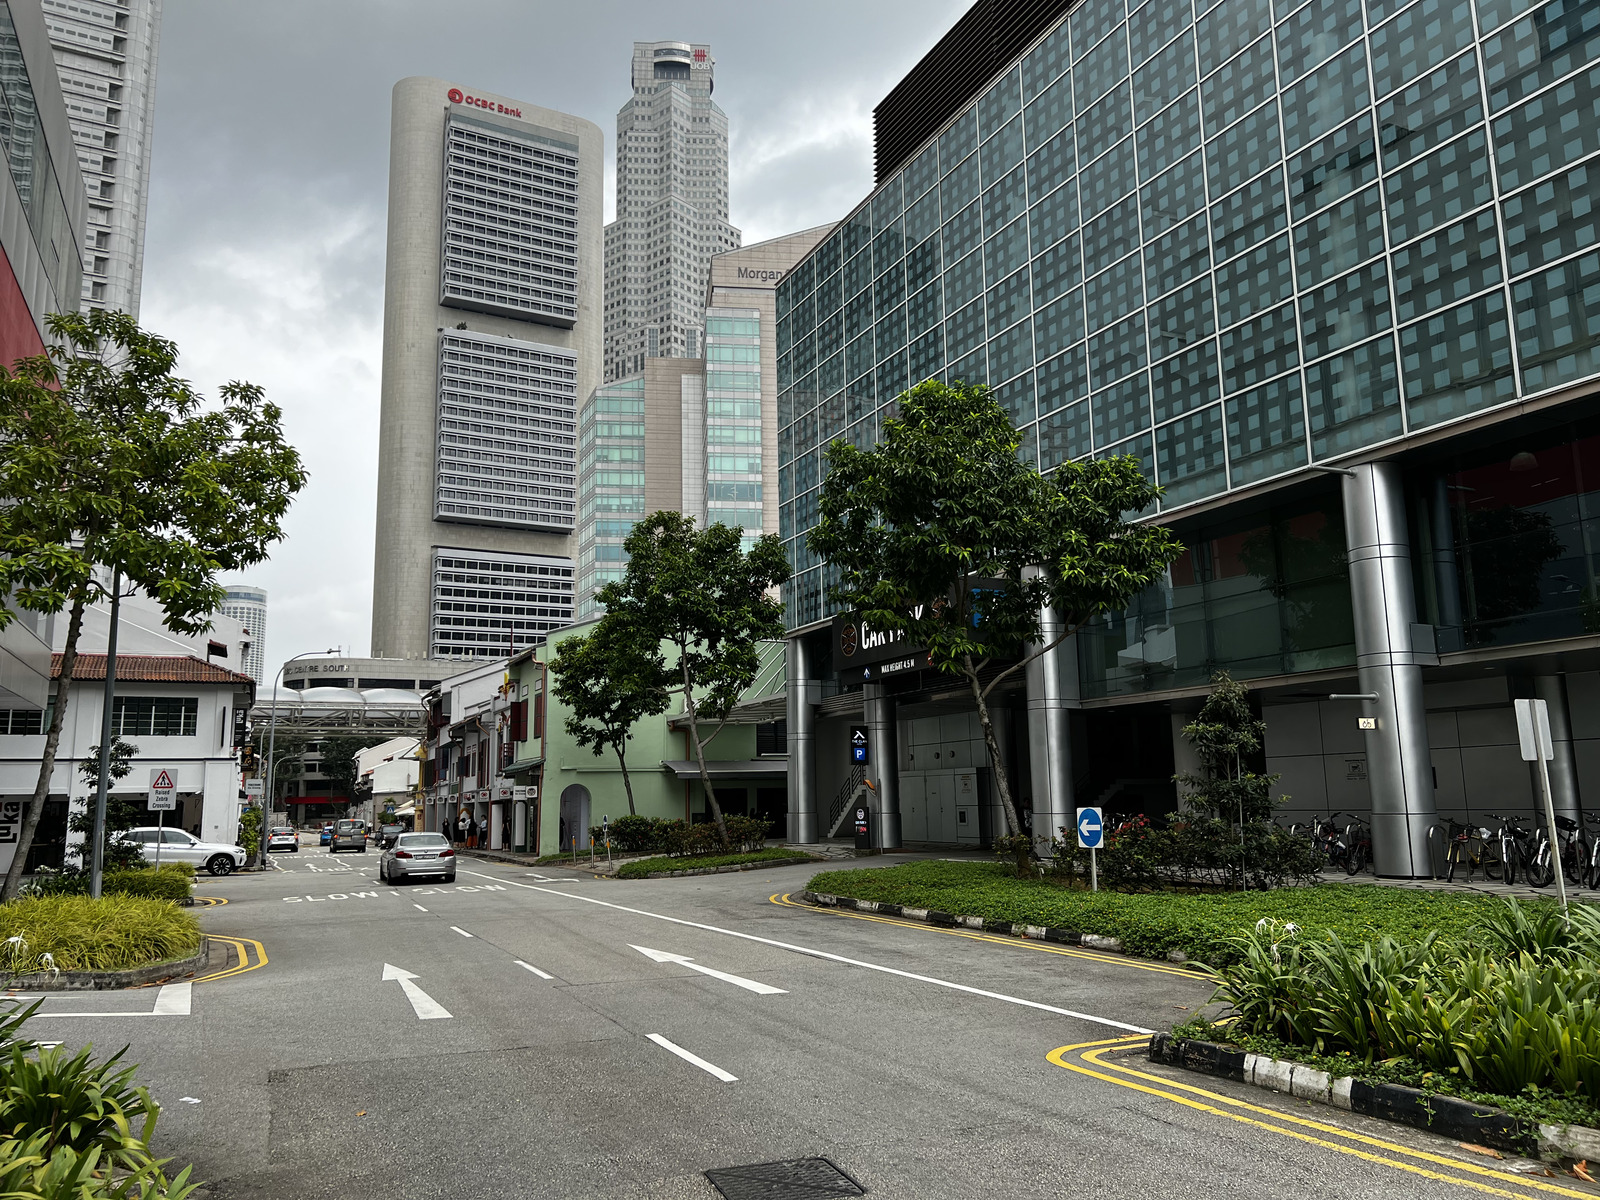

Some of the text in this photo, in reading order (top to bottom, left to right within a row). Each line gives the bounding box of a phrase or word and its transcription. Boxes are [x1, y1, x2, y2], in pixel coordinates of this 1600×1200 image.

[690, 62, 710, 70] UOB
[465, 95, 522, 118] OCBC Bank
[737, 266, 783, 282] Morgan
[881, 665, 889, 674] MAX
[890, 661, 903, 672] HEIGHT
[910, 658, 914, 667] M
[0, 802, 20, 843] Luka
[282, 884, 507, 902] SLOW SLOW
